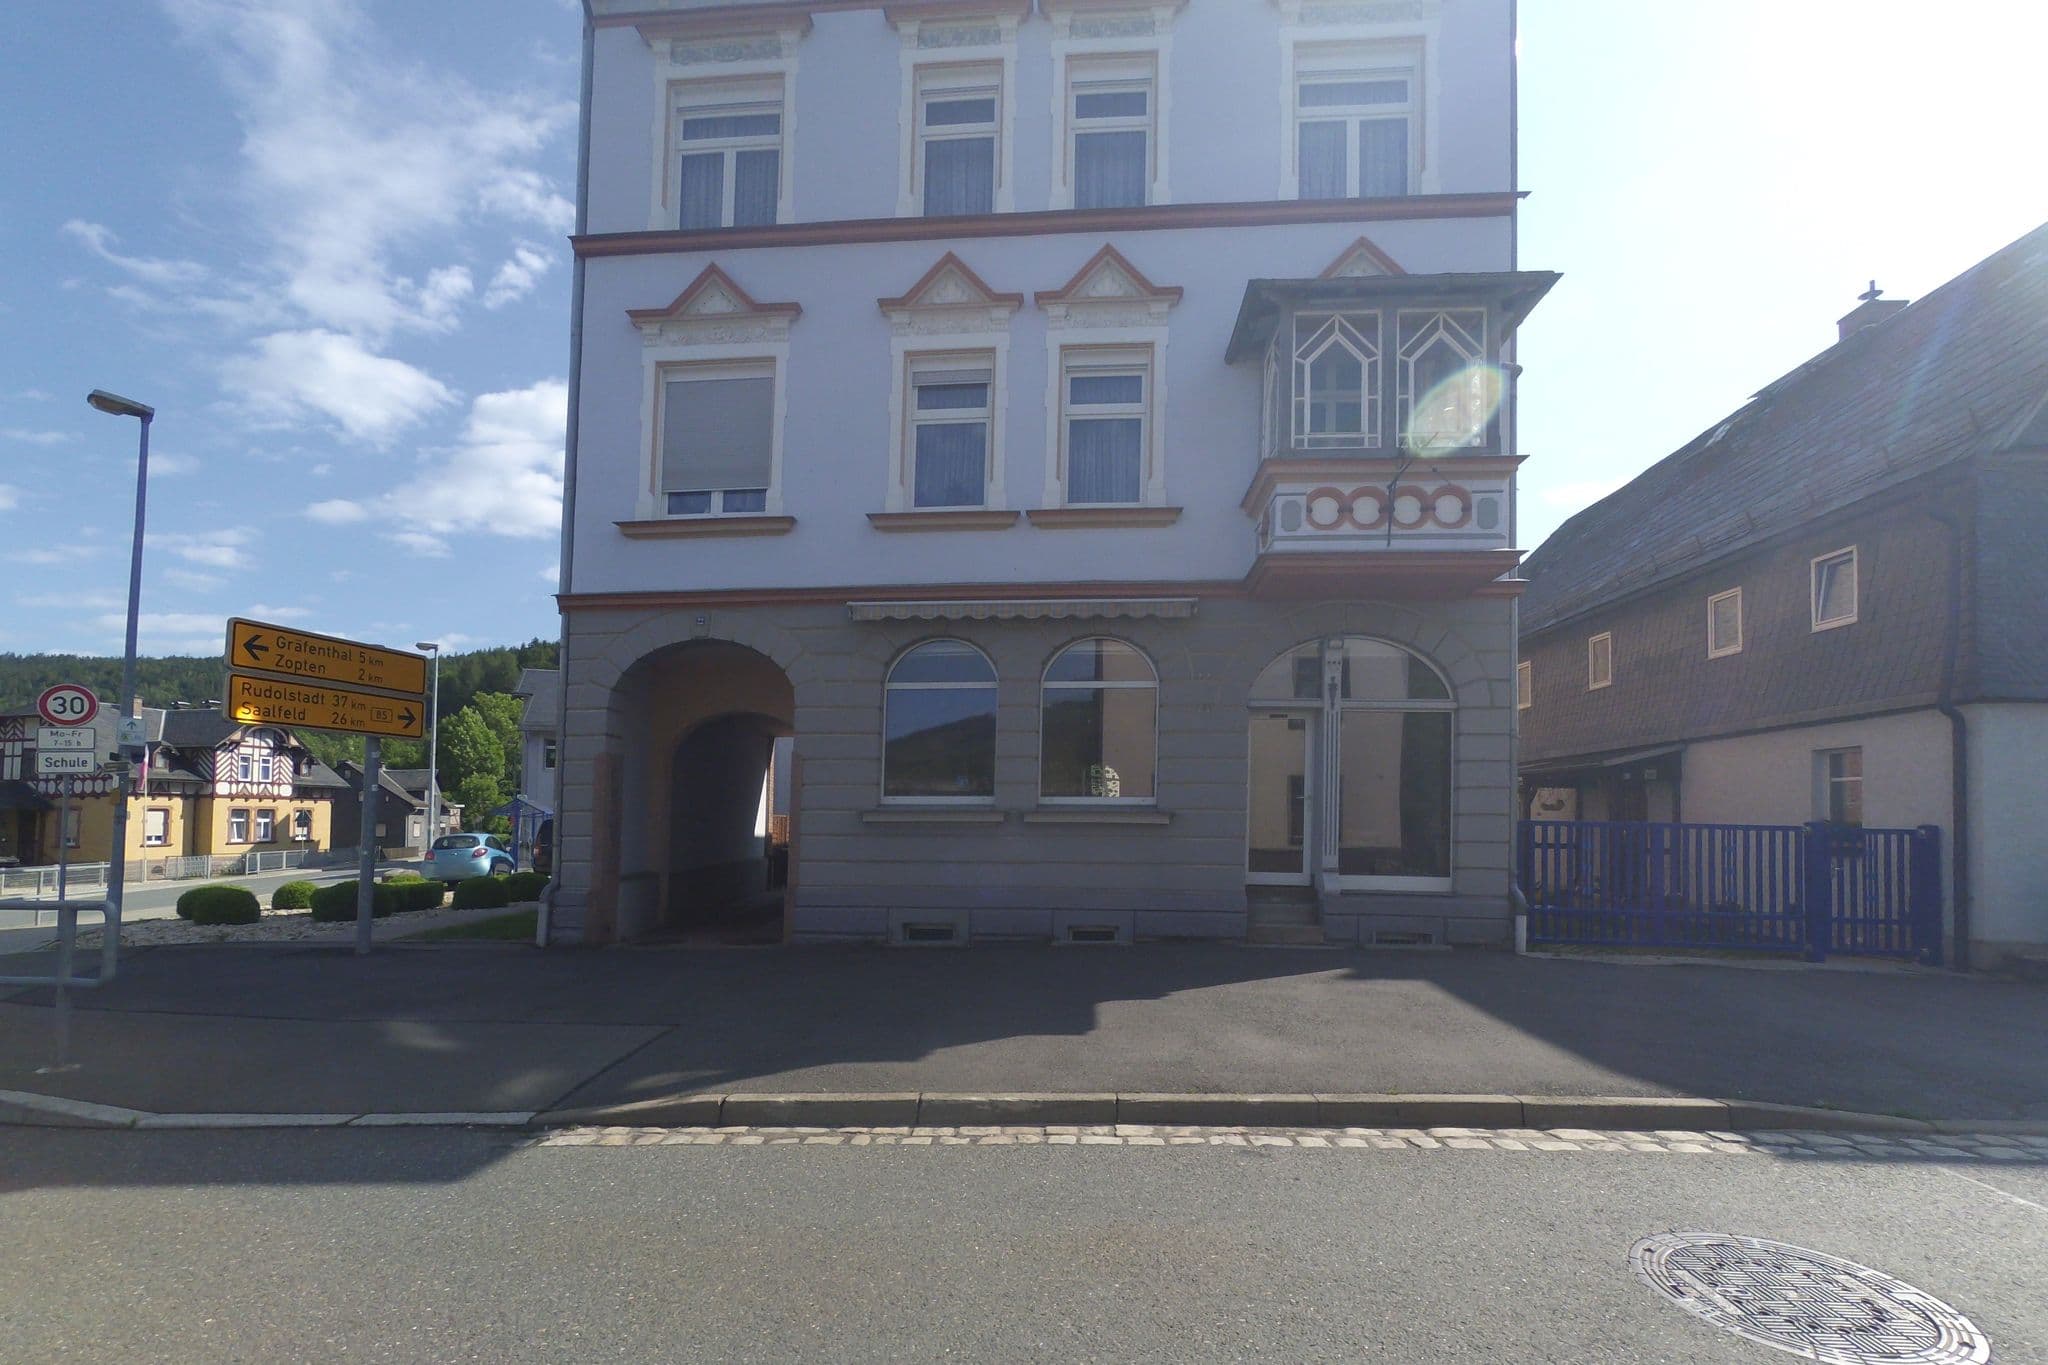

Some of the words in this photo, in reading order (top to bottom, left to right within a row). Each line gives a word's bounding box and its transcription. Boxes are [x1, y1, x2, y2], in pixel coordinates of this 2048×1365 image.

[276, 635, 353, 662] Gräfenthal
[359, 651, 366, 664] 5
[368, 656, 384, 667] km
[275, 653, 326, 675] Zopten
[357, 668, 365, 681] 2
[368, 673, 383, 684] km
[52, 696, 85, 715] 30
[241, 682, 325, 705] Rudolstadt
[331, 695, 348, 708] 37
[351, 700, 367, 711] km
[241, 701, 306, 721] Saalfeld
[331, 711, 348, 725] 26
[350, 717, 366, 728] km
[45, 756, 88, 768] Schule
